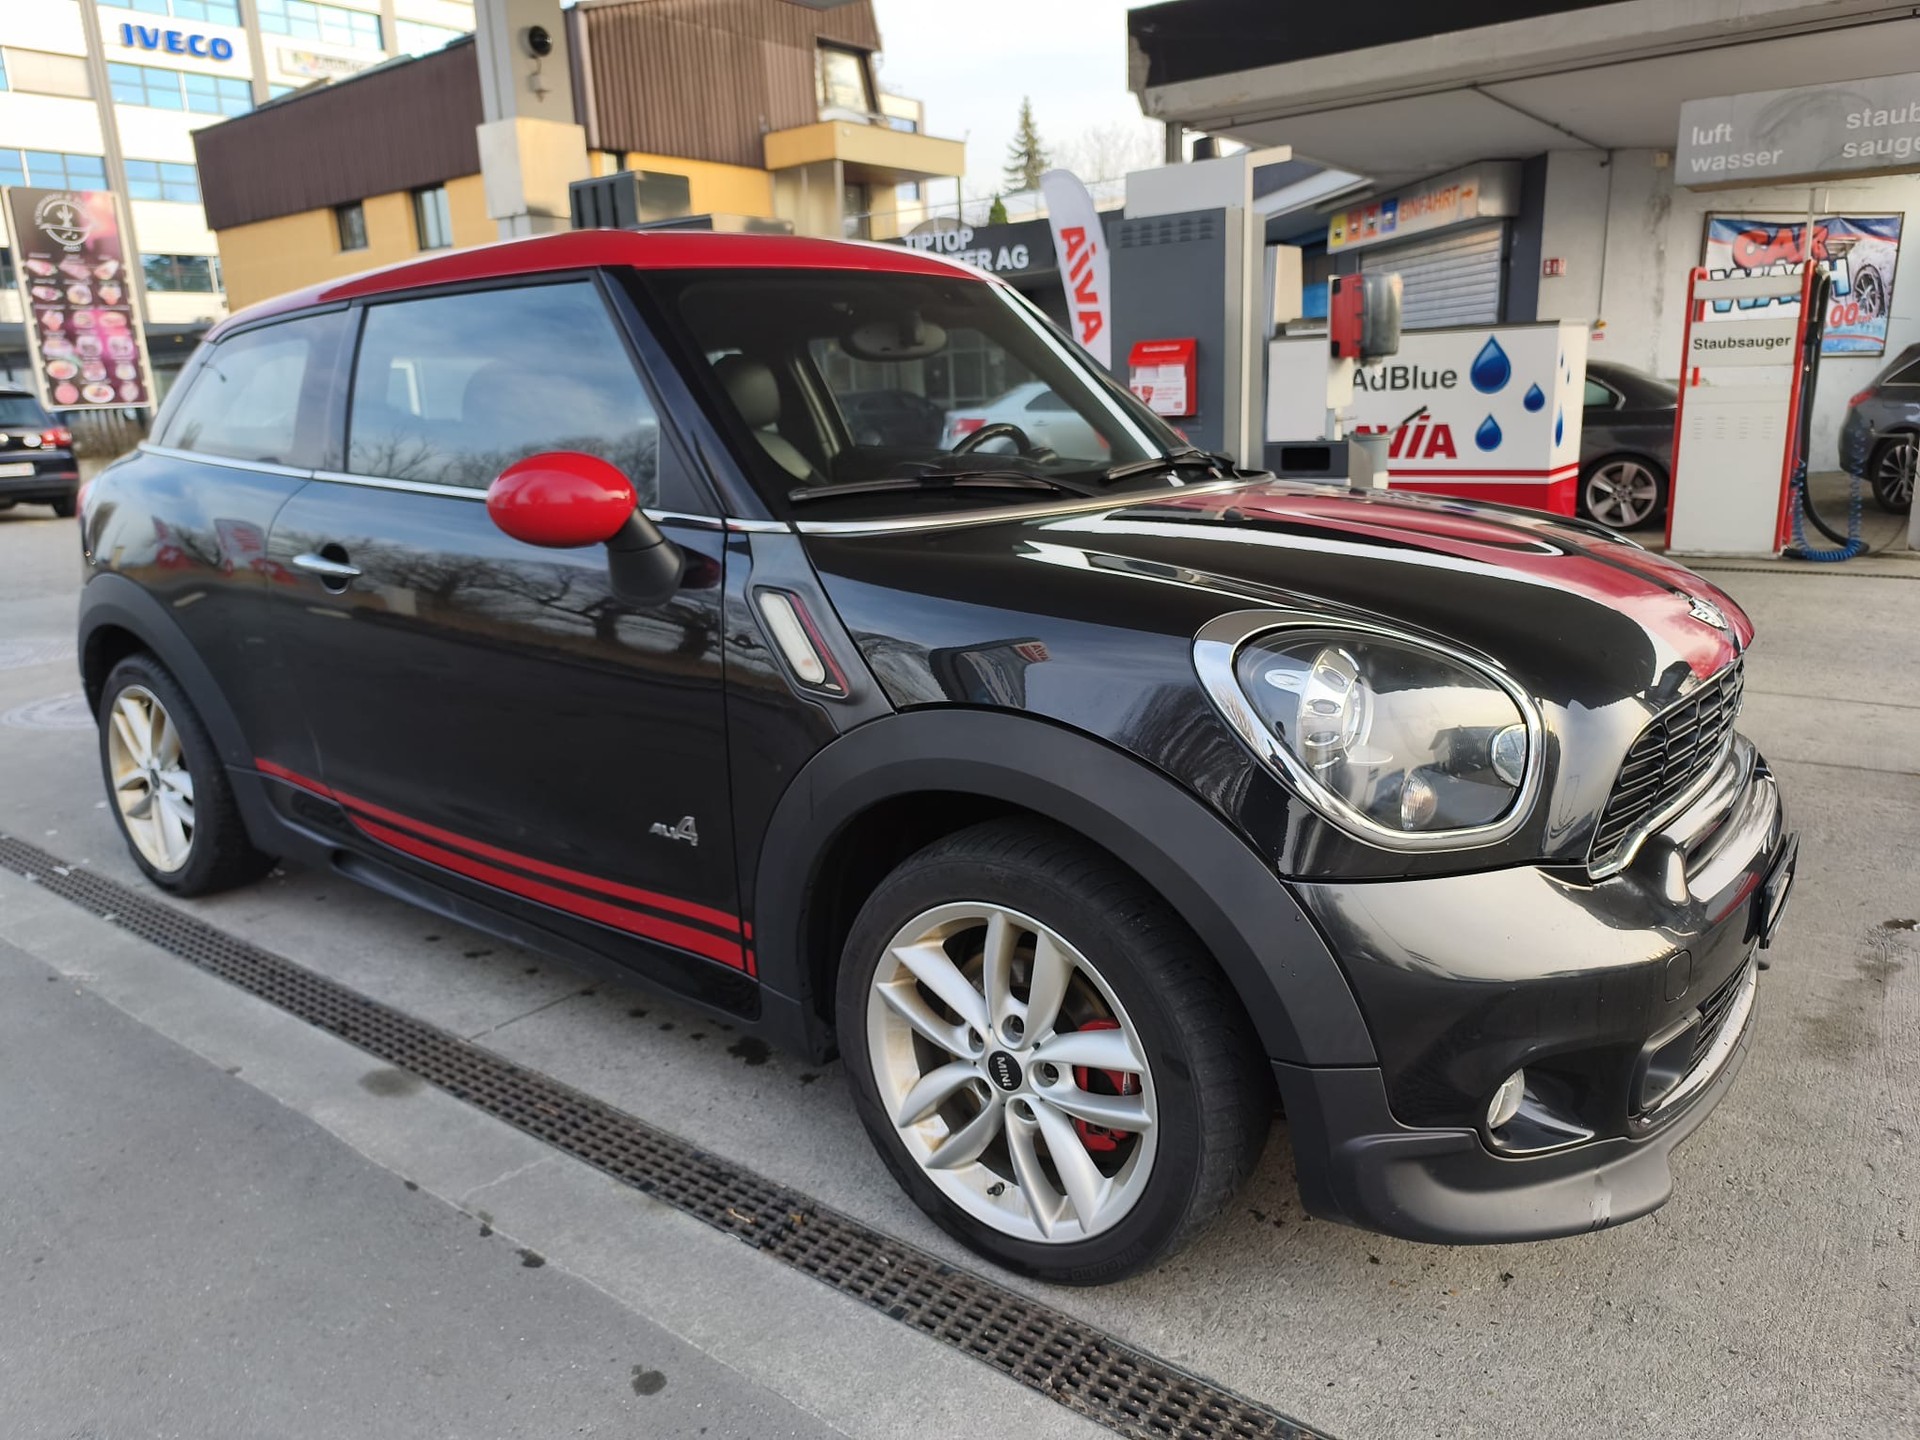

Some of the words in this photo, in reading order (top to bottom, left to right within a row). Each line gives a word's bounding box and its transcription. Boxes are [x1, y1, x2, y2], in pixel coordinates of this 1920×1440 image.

[119, 23, 233, 61] IVECO
[1846, 102, 1920, 129] staub
[1691, 123, 1733, 147] luft
[1690, 149, 1783, 173] wasser
[1399, 184, 1460, 222] EINFAHRT
[904, 227, 974, 252] TIPTOP
[1733, 226, 1829, 269] CAR
[995, 244, 1029, 270] AG
[1693, 336, 1792, 351] Staubsauger
[1352, 364, 1458, 391] AdBlue
[996, 1056, 1012, 1087] MINI
